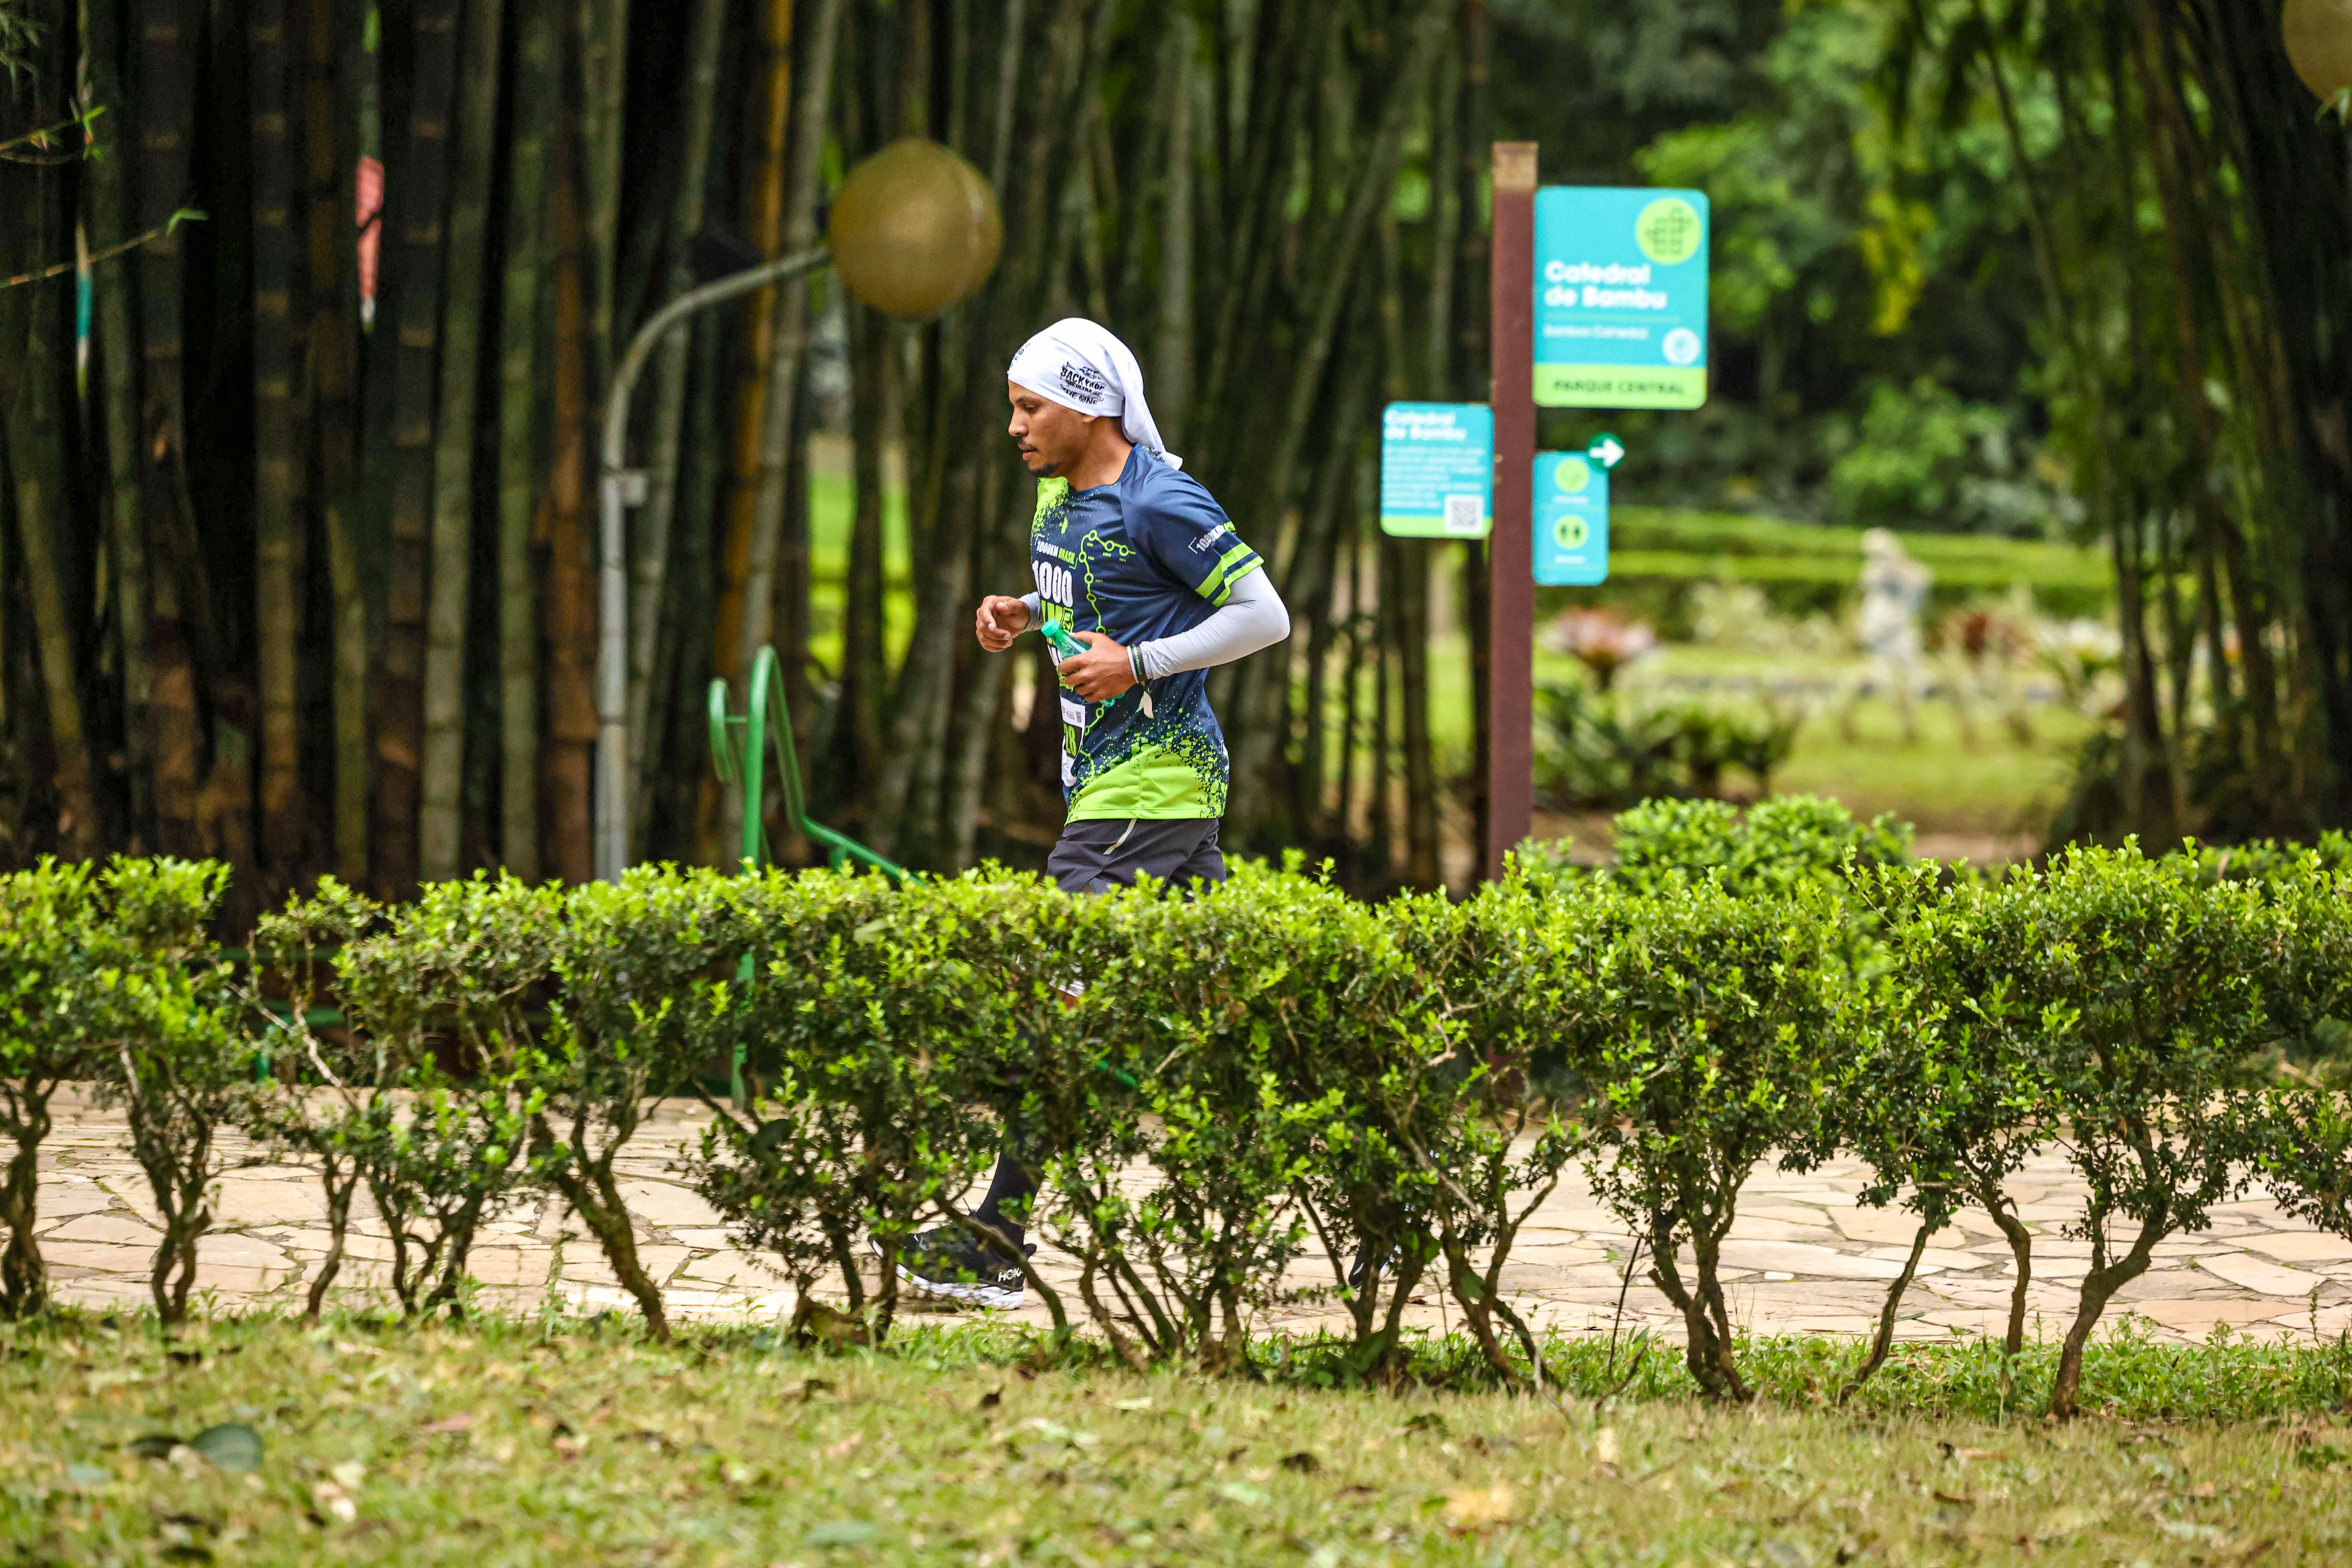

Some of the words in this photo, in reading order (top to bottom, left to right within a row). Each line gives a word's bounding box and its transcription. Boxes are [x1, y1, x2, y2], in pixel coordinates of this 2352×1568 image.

[1545, 260, 1650, 285] Catedral
[1545, 285, 1577, 307] de
[1583, 286, 1667, 309] Bambu
[1553, 379, 1612, 394] PARQUE
[1617, 381, 1684, 394] CENTRAL
[1036, 540, 1059, 558] 1000KM
[1058, 547, 1076, 565] BRASIL
[1032, 560, 1073, 608] 1000
